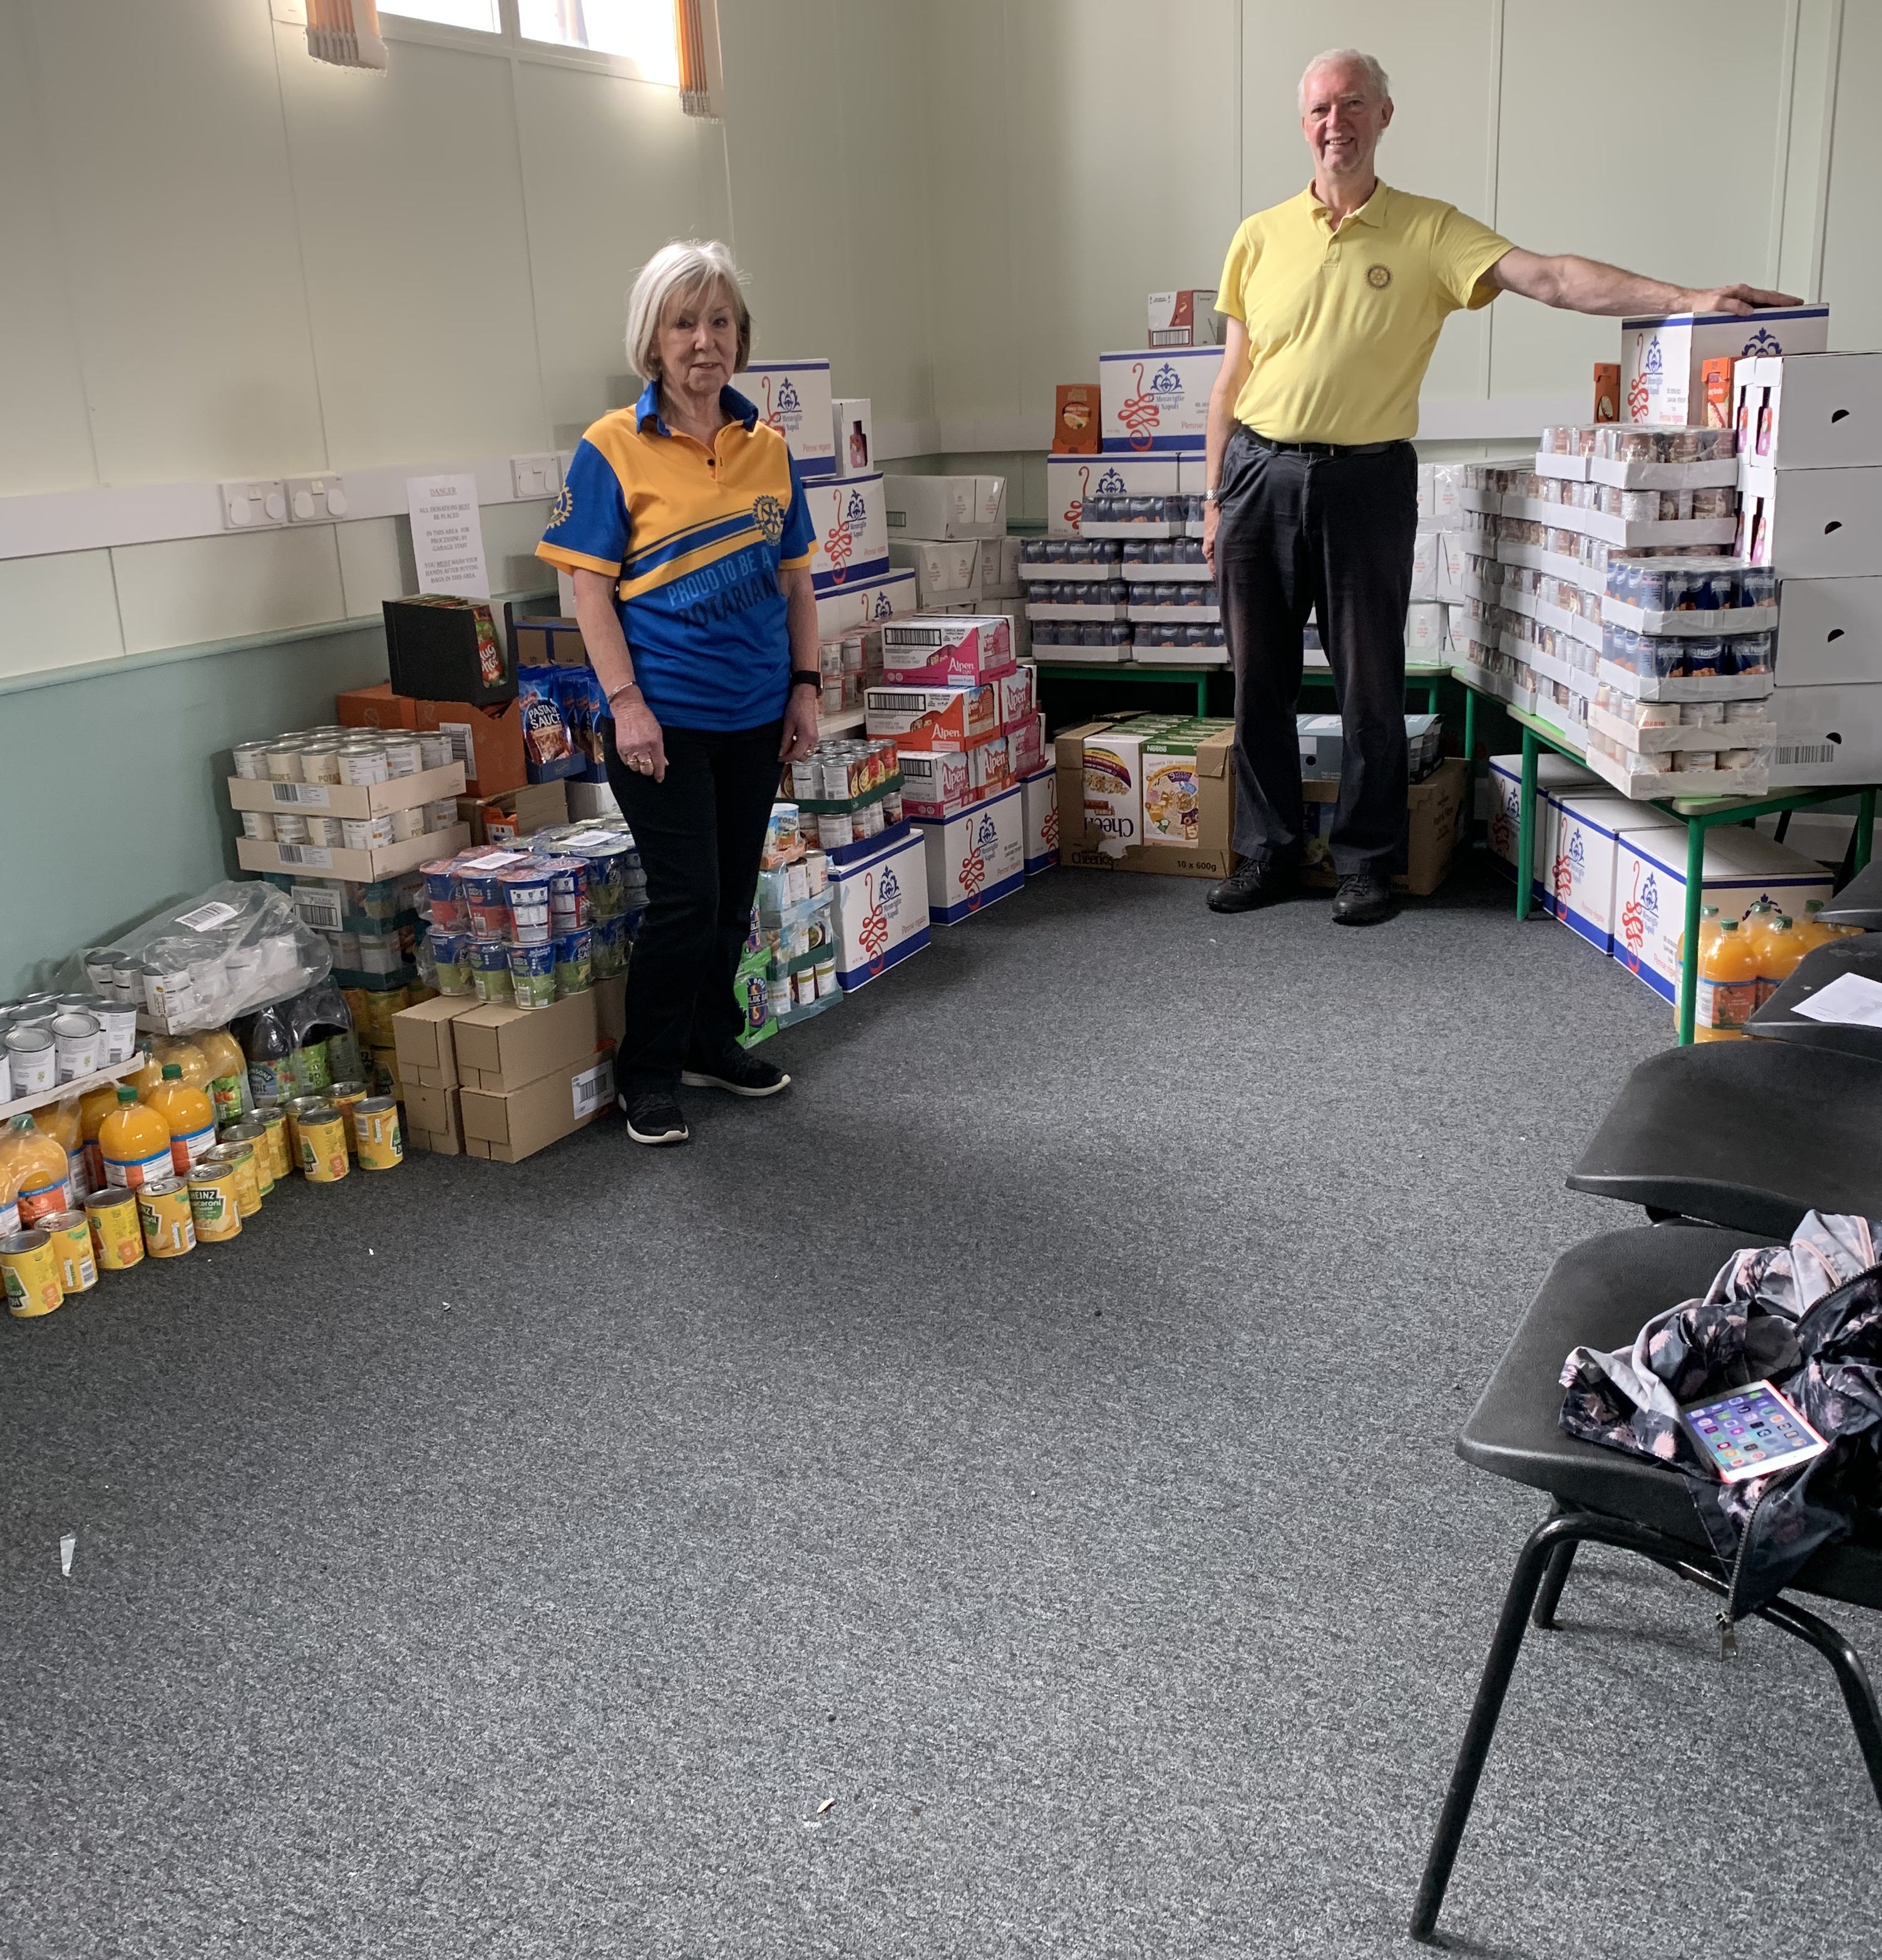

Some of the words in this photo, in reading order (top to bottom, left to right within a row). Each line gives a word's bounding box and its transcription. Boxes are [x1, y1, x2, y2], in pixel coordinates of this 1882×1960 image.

[1156, 395, 1185, 403] Meraviglie
[1160, 402, 1180, 411] Napoli
[1181, 421, 1204, 430] Penne
[429, 487, 457, 497] DANGER
[430, 505, 458, 513] DONATIONS
[431, 535, 461, 544] PROCESSING
[433, 544, 453, 552] GARAGE
[425, 569, 443, 577] HANDS
[460, 564, 479, 572] PUTTING
[666, 568, 720, 607] PROUD
[717, 559, 738, 584] TO
[737, 550, 758, 577] BE
[761, 546, 772, 569] A
[674, 573, 779, 629] ROTARIAN
[948, 657, 974, 673] Alpen
[1007, 689, 1026, 711] Alpen
[528, 704, 550, 720] PASTA
[969, 703, 979, 714] pen
[530, 713, 561, 730] SAUCE
[931, 723, 959, 740] Alpen
[985, 750, 1005, 775] Alpen
[942, 766, 966, 790] Alpen
[779, 817, 797, 826] rosia
[1177, 860, 1186, 869] 10
[1196, 861, 1217, 872] 600g
[251, 1068, 272, 1081] NSONS
[251, 1084, 267, 1093] ruit
[190, 1191, 215, 1200] HEINZ
[141, 1206, 151, 1215] NZ
[141, 1216, 157, 1224] roni
